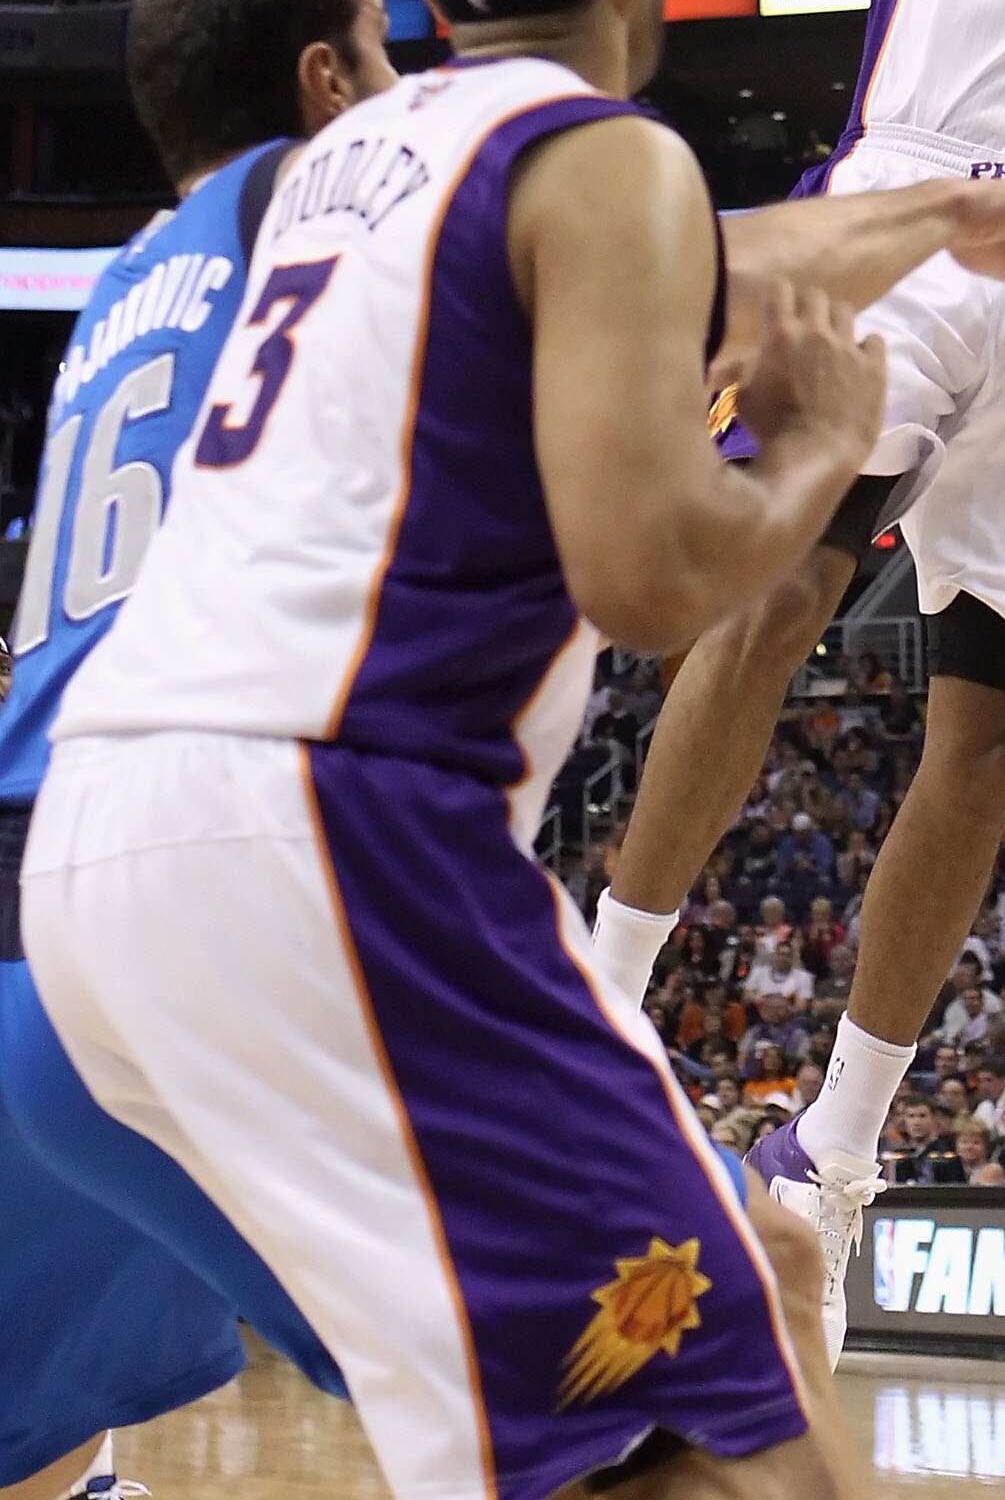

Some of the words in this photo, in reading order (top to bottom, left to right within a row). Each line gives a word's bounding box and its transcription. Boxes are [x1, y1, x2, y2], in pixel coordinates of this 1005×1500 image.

[272, 137, 429, 243] DUDLEY
[194, 252, 342, 471] 3
[9, 352, 176, 657] 16
